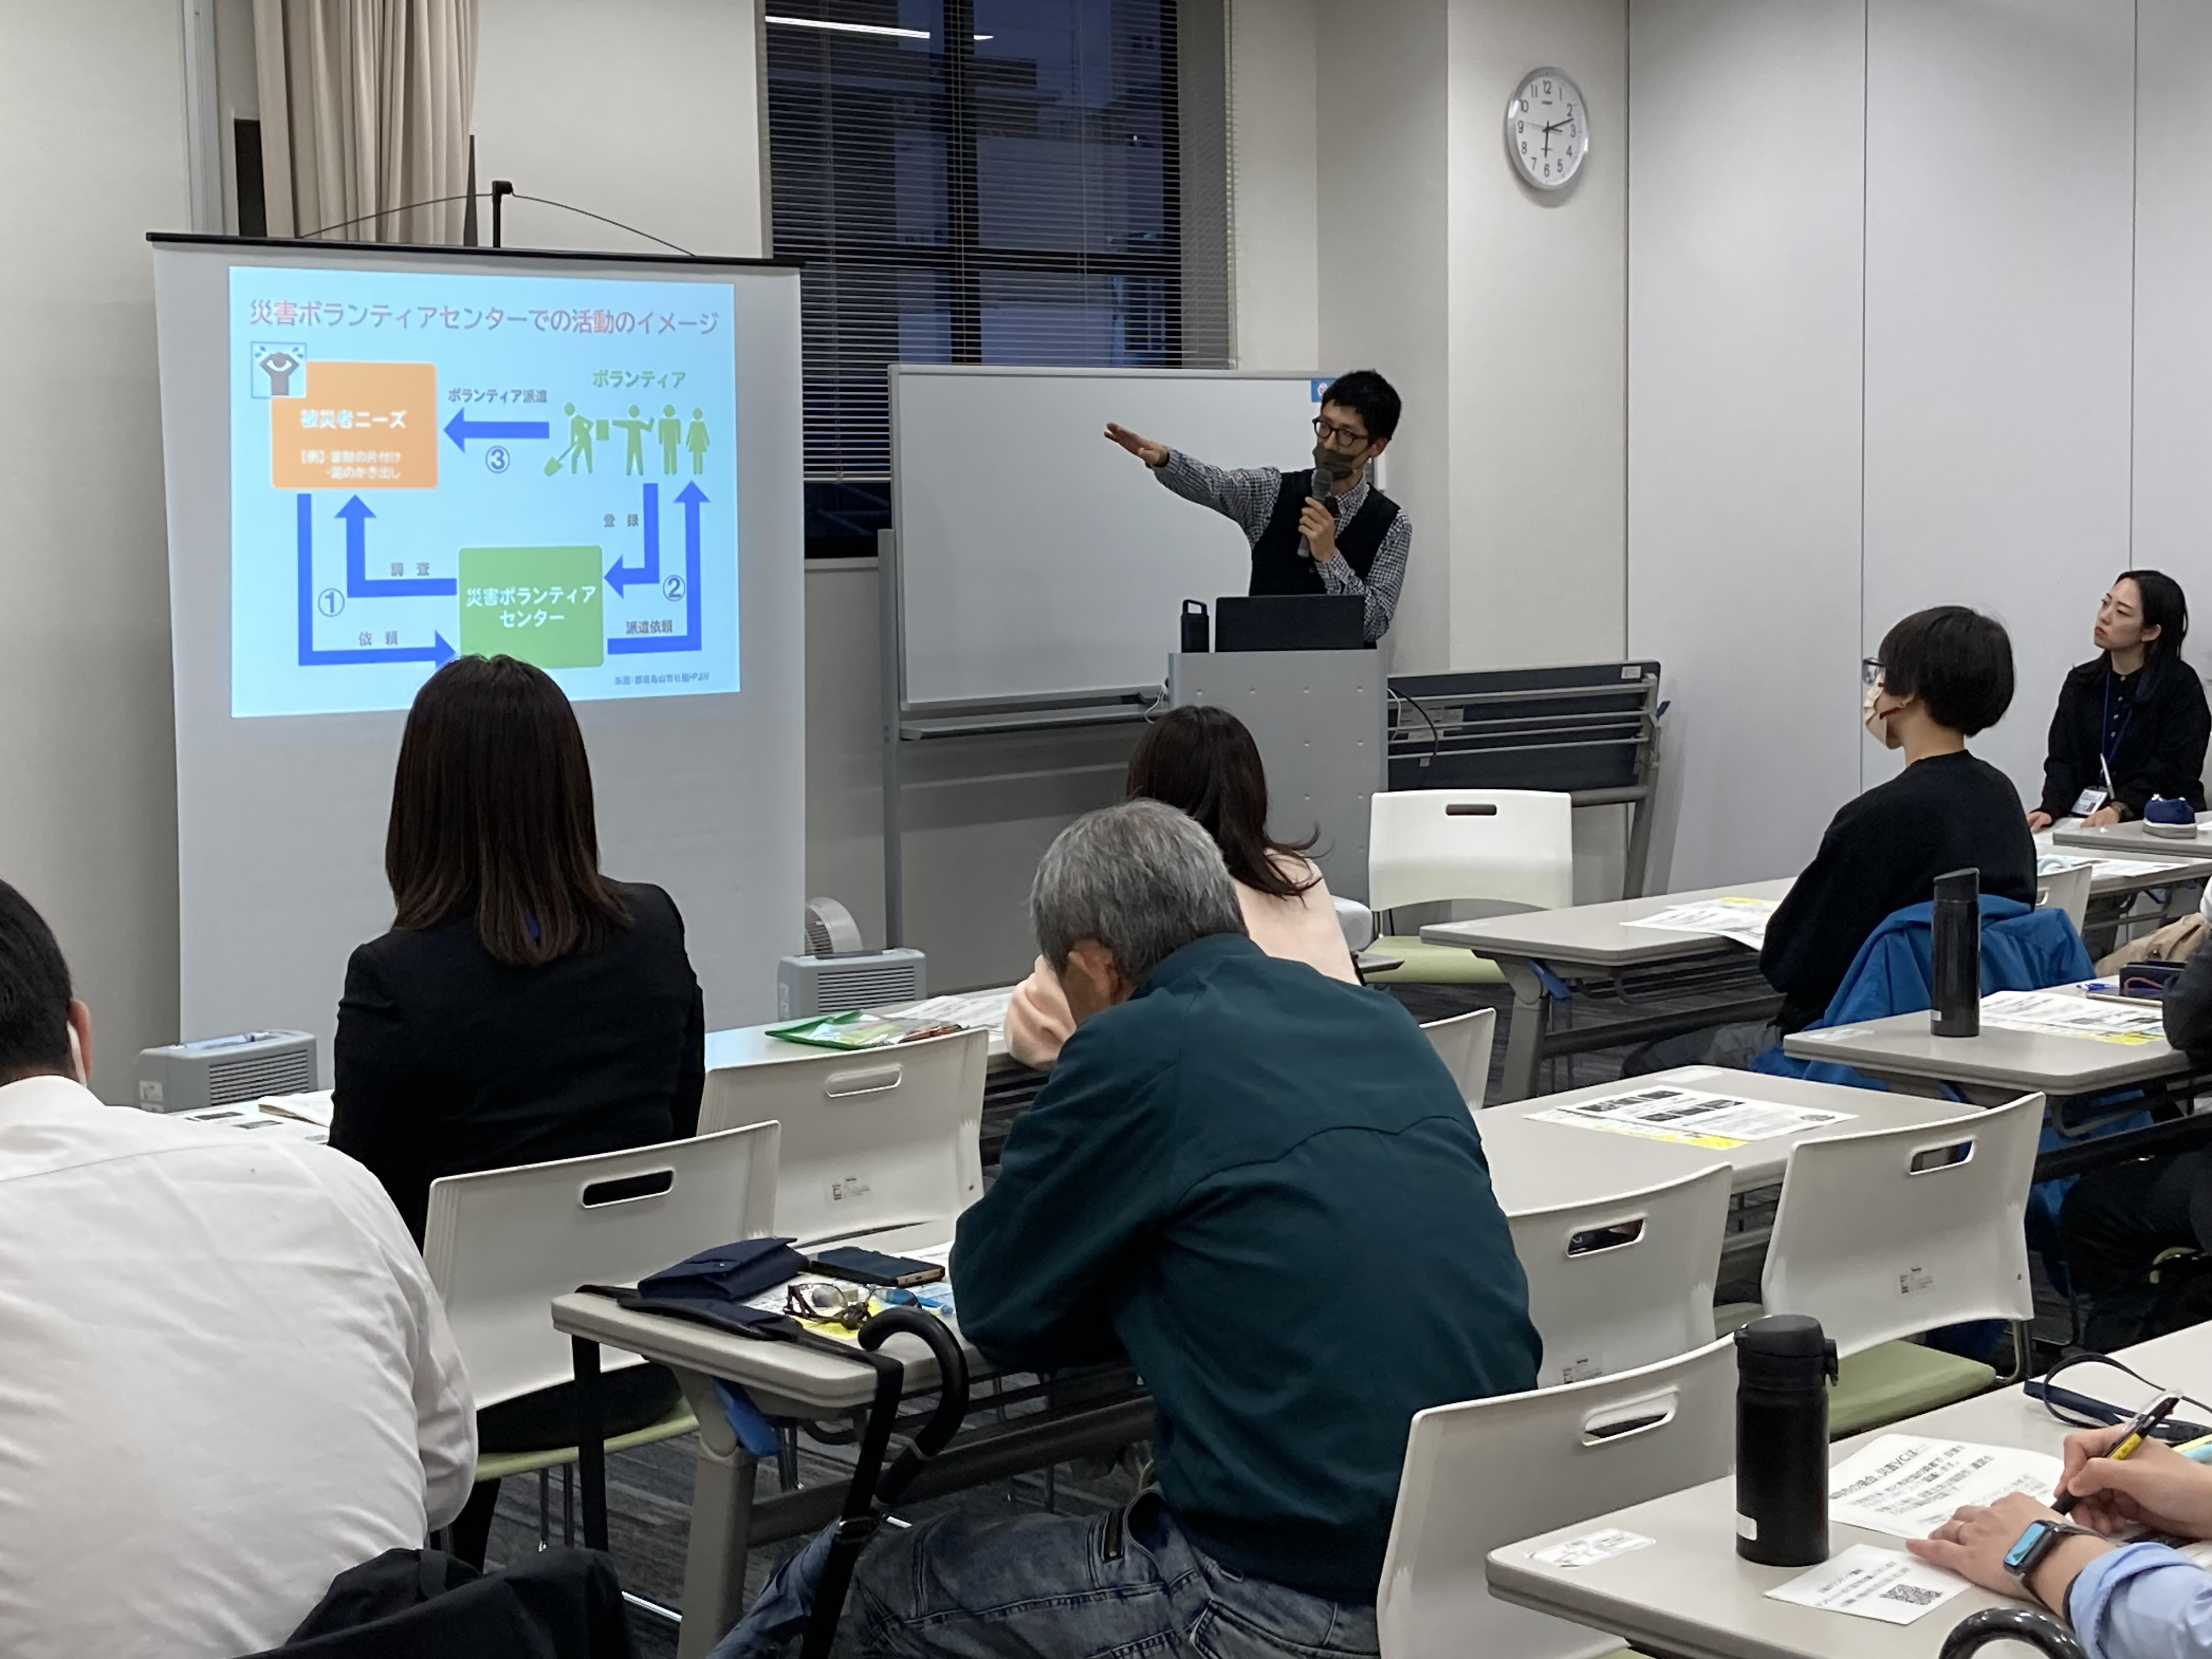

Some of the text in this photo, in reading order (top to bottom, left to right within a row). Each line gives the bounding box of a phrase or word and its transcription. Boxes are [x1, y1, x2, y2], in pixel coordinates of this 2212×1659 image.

[1531, 84, 1538, 98] 11
[1543, 80, 1551, 94] 12
[1559, 87, 1562, 101] 1
[1520, 99, 1529, 112] 10
[1567, 103, 1573, 116] 2
[1517, 120, 1524, 133] 9
[1570, 125, 1576, 138] 3
[1521, 141, 1527, 154] 8
[1566, 145, 1573, 157] 4
[1531, 156, 1537, 171] 7
[1543, 163, 1550, 177] 6
[1556, 159, 1563, 173] 5
[250, 299, 719, 335] 災害ボランティアセンターでの活動のイメージ
[593, 369, 686, 388] ボランティア
[448, 388, 548, 404] ボランティア派遣
[300, 409, 407, 430] 被災者ニーズ
[466, 585, 596, 607] 災害ボランティア
[500, 608, 565, 628] センター
